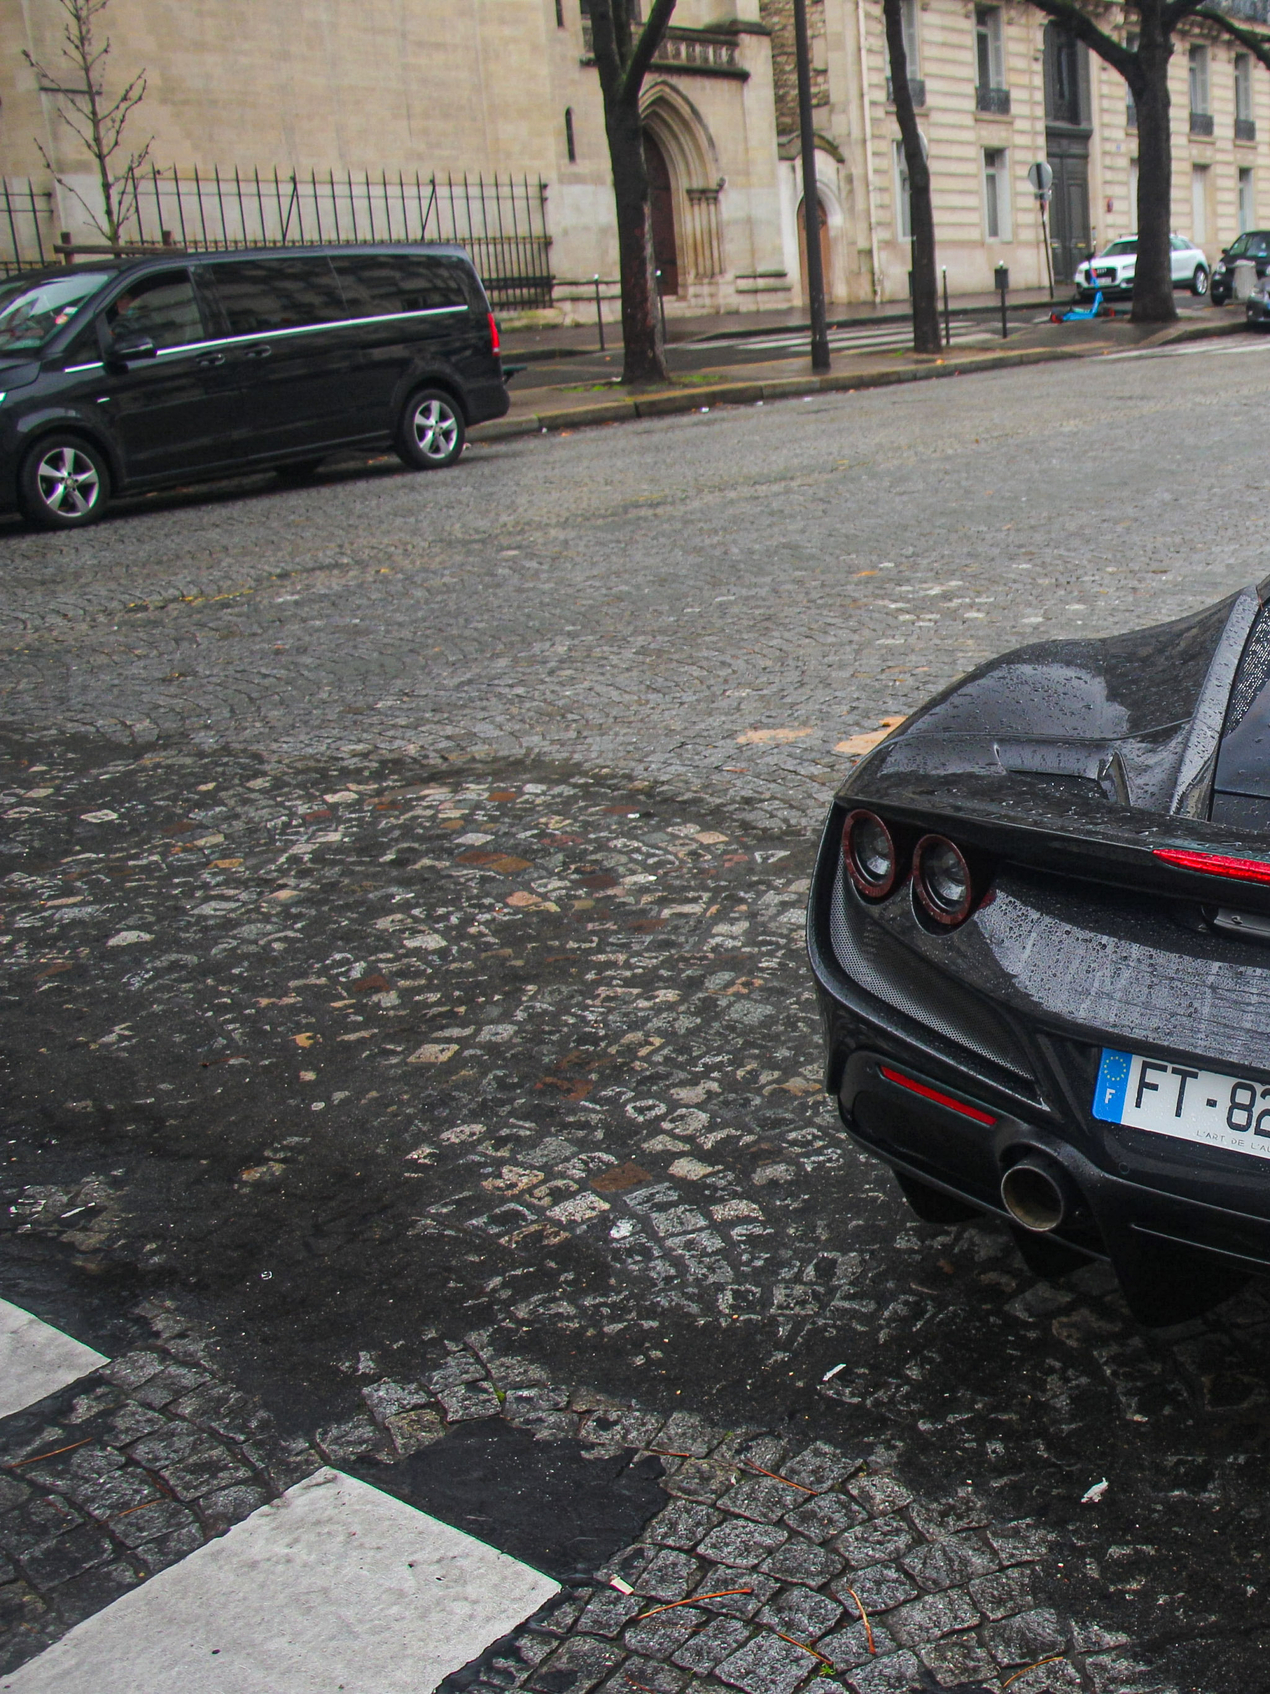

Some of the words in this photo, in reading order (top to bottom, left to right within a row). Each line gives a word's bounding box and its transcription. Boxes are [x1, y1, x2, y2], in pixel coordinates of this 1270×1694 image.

[1105, 1088, 1116, 1104] F
[1196, 1130, 1226, 1142] L'ART
[1231, 1138, 1245, 1147] DE
